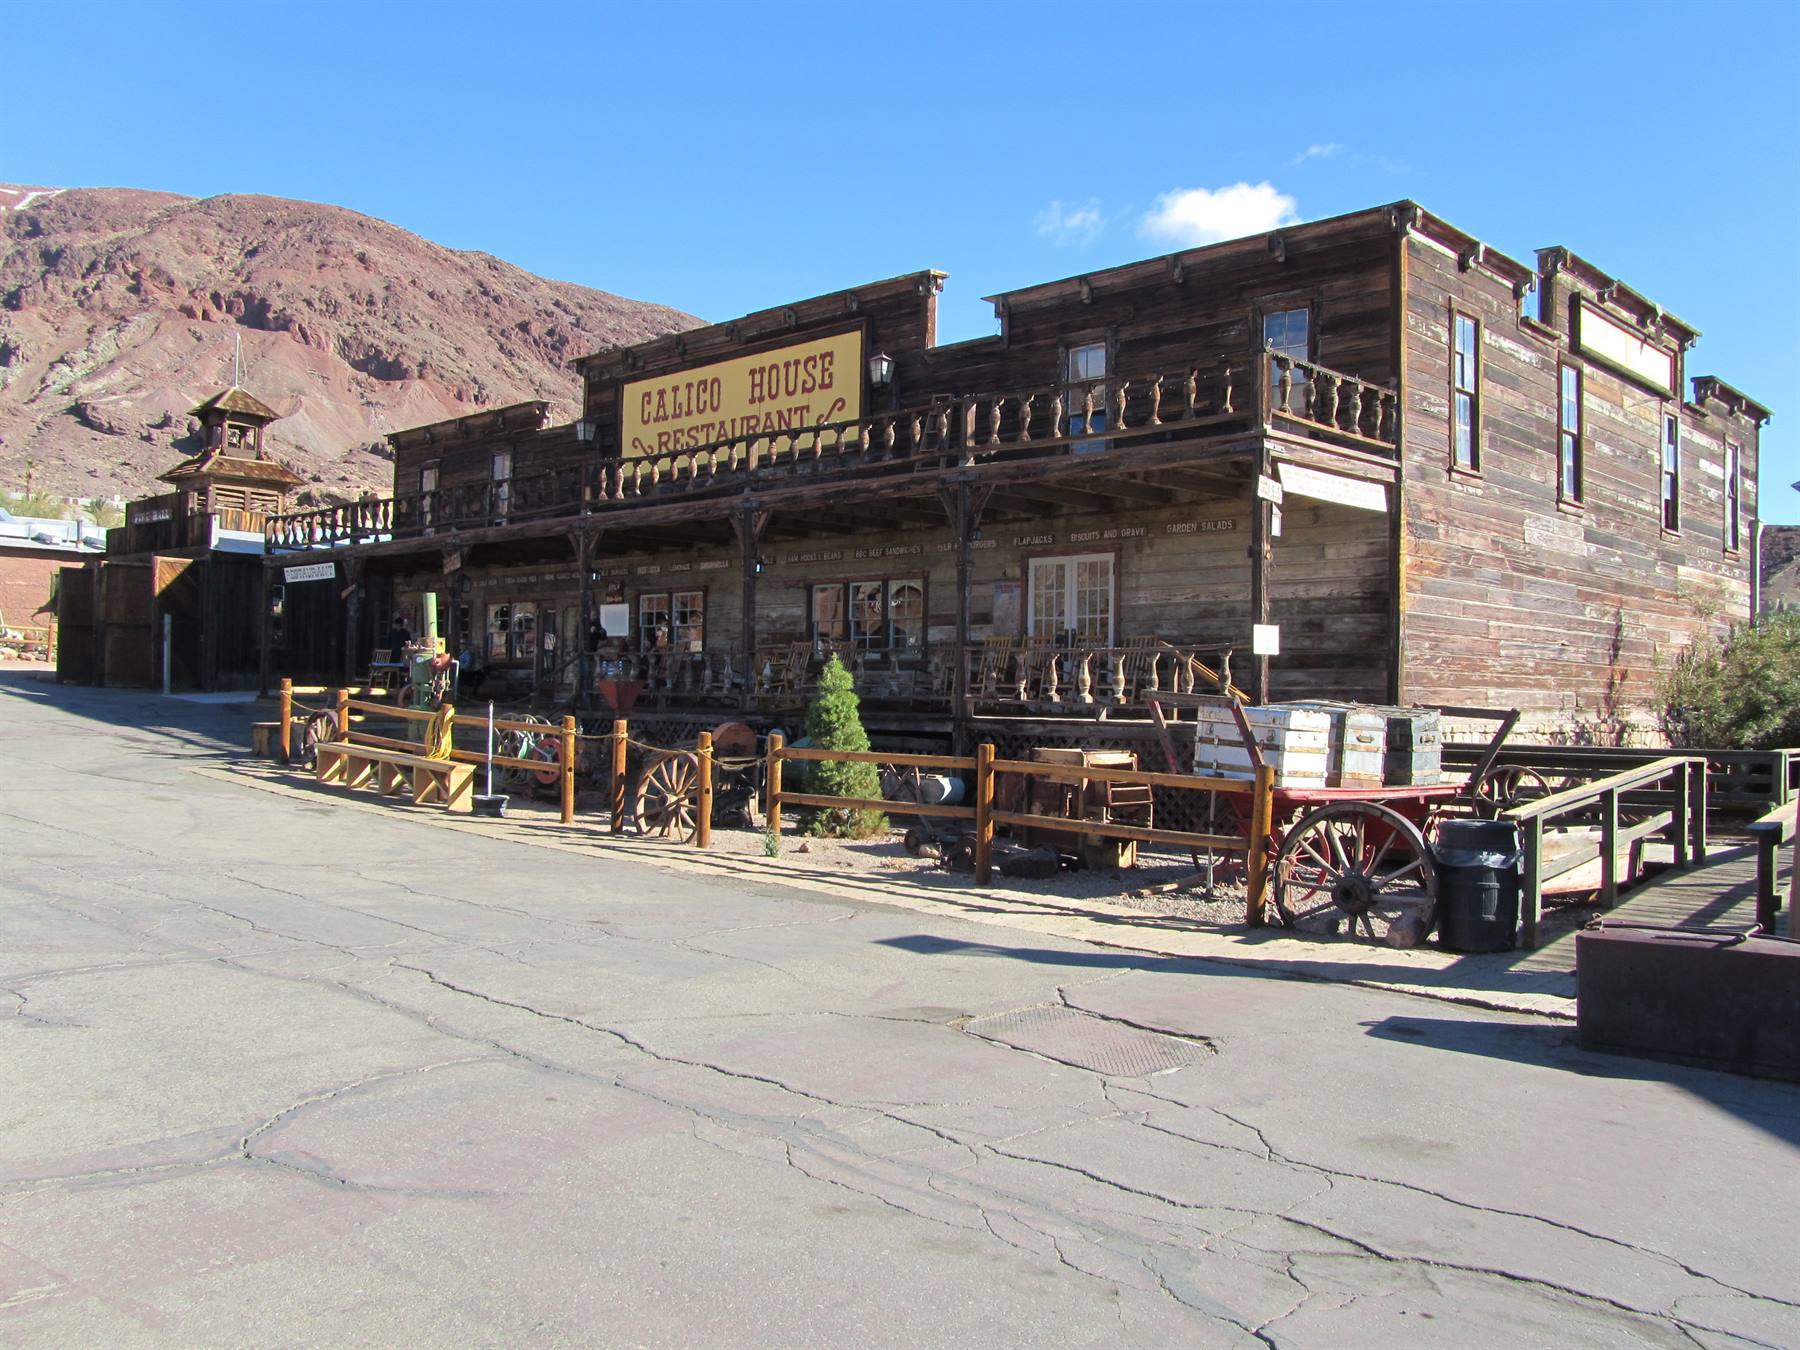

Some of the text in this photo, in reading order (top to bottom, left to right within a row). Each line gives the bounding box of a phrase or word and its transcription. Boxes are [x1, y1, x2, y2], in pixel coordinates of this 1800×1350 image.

[641, 351, 834, 425] CALICO HOUSE
[657, 405, 810, 453] RESTAURANT
[1166, 519, 1233, 534] GARDEN SALADS
[1013, 535, 1053, 547] FLAPJACKS
[1070, 530, 1100, 542] BISCUITS
[1103, 529, 1118, 539] AND
